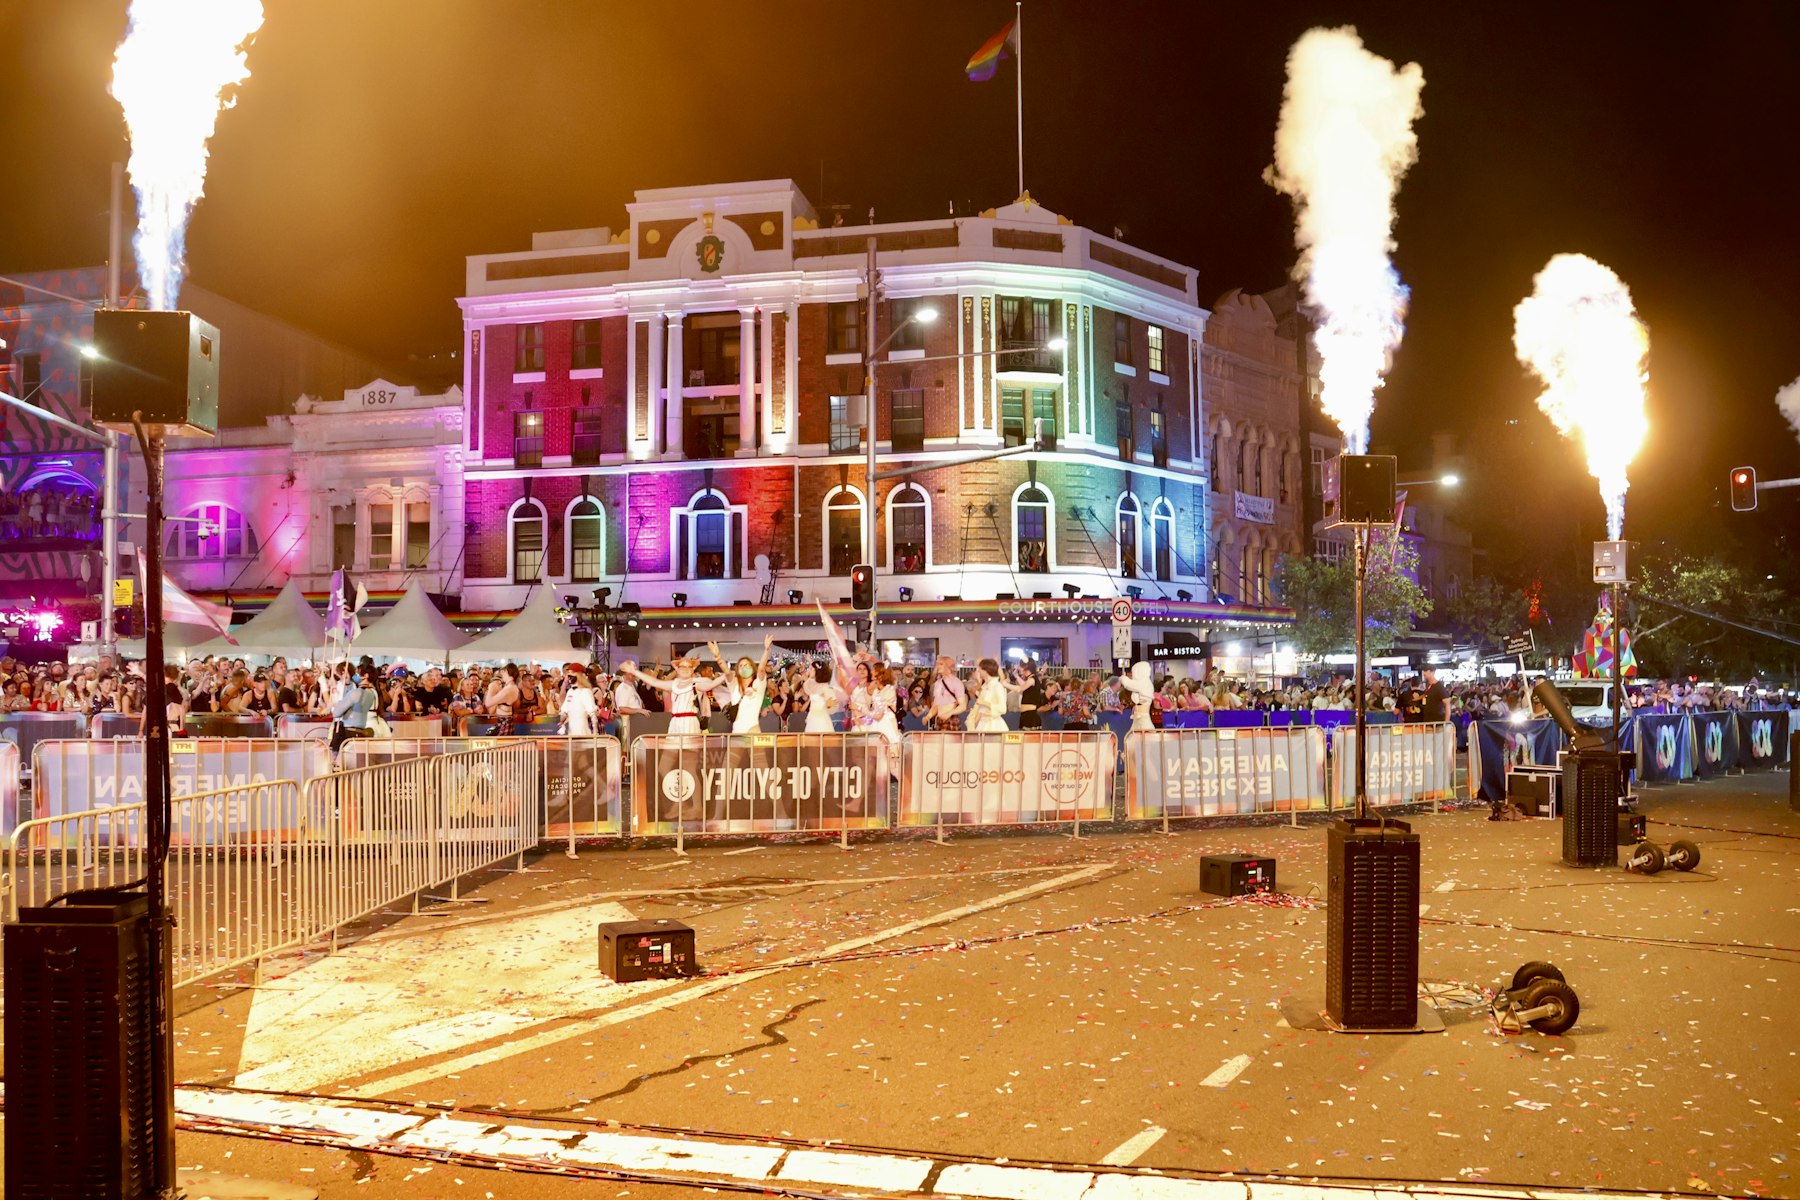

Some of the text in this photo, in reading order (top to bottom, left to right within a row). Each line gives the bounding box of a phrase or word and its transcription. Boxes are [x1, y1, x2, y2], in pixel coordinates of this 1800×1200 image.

[362, 390, 397, 405] 1887
[998, 600, 1162, 614] COURTHOUSE OTEL
[1115, 606, 1129, 616] 40
[1154, 646, 1201, 656] BAR BISTRO
